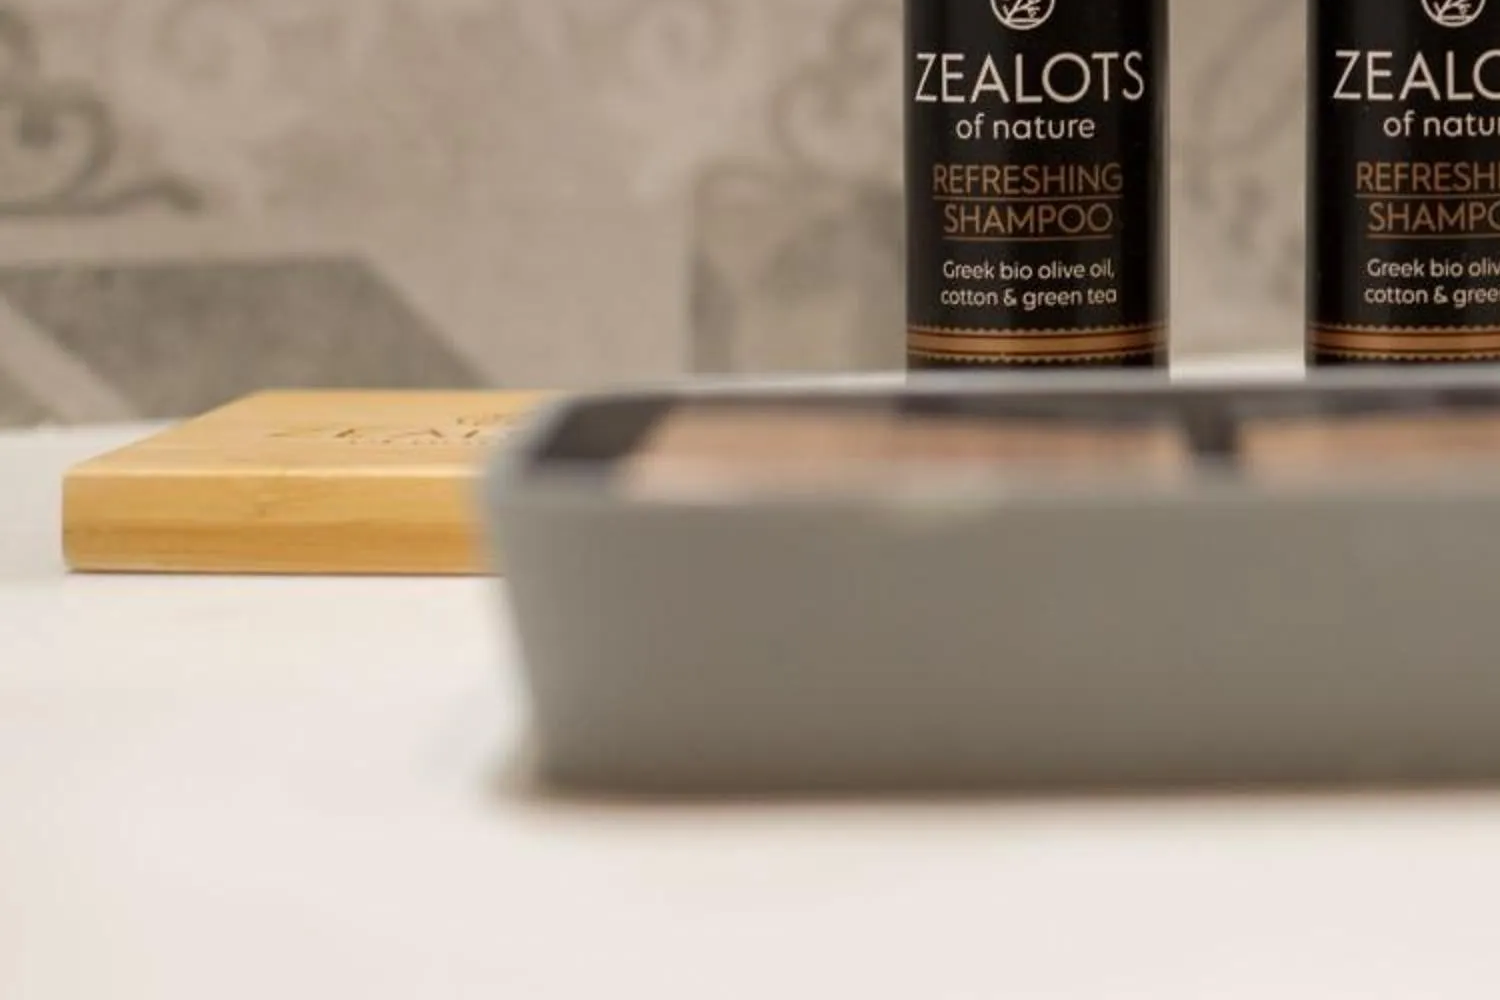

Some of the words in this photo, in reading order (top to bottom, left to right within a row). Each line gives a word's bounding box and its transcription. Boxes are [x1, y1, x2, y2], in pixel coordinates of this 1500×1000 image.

[915, 51, 1144, 104] ZEALOTS
[956, 113, 985, 140] of
[993, 115, 1095, 140] nature
[1383, 110, 1415, 137] of
[933, 162, 1123, 195] REFRESHING
[943, 204, 1113, 234] SHAMPOO
[943, 260, 995, 280] Greek
[1000, 262, 1033, 280] bio
[1038, 261, 1085, 279] olive
[1367, 258, 1424, 277] Greek
[1430, 258, 1464, 277] bio
[940, 289, 998, 306] cotton
[1003, 289, 1016, 306] &
[1024, 289, 1083, 310] green
[1087, 287, 1116, 304] tea
[1364, 287, 1427, 304] cotton
[1433, 287, 1448, 303] &
